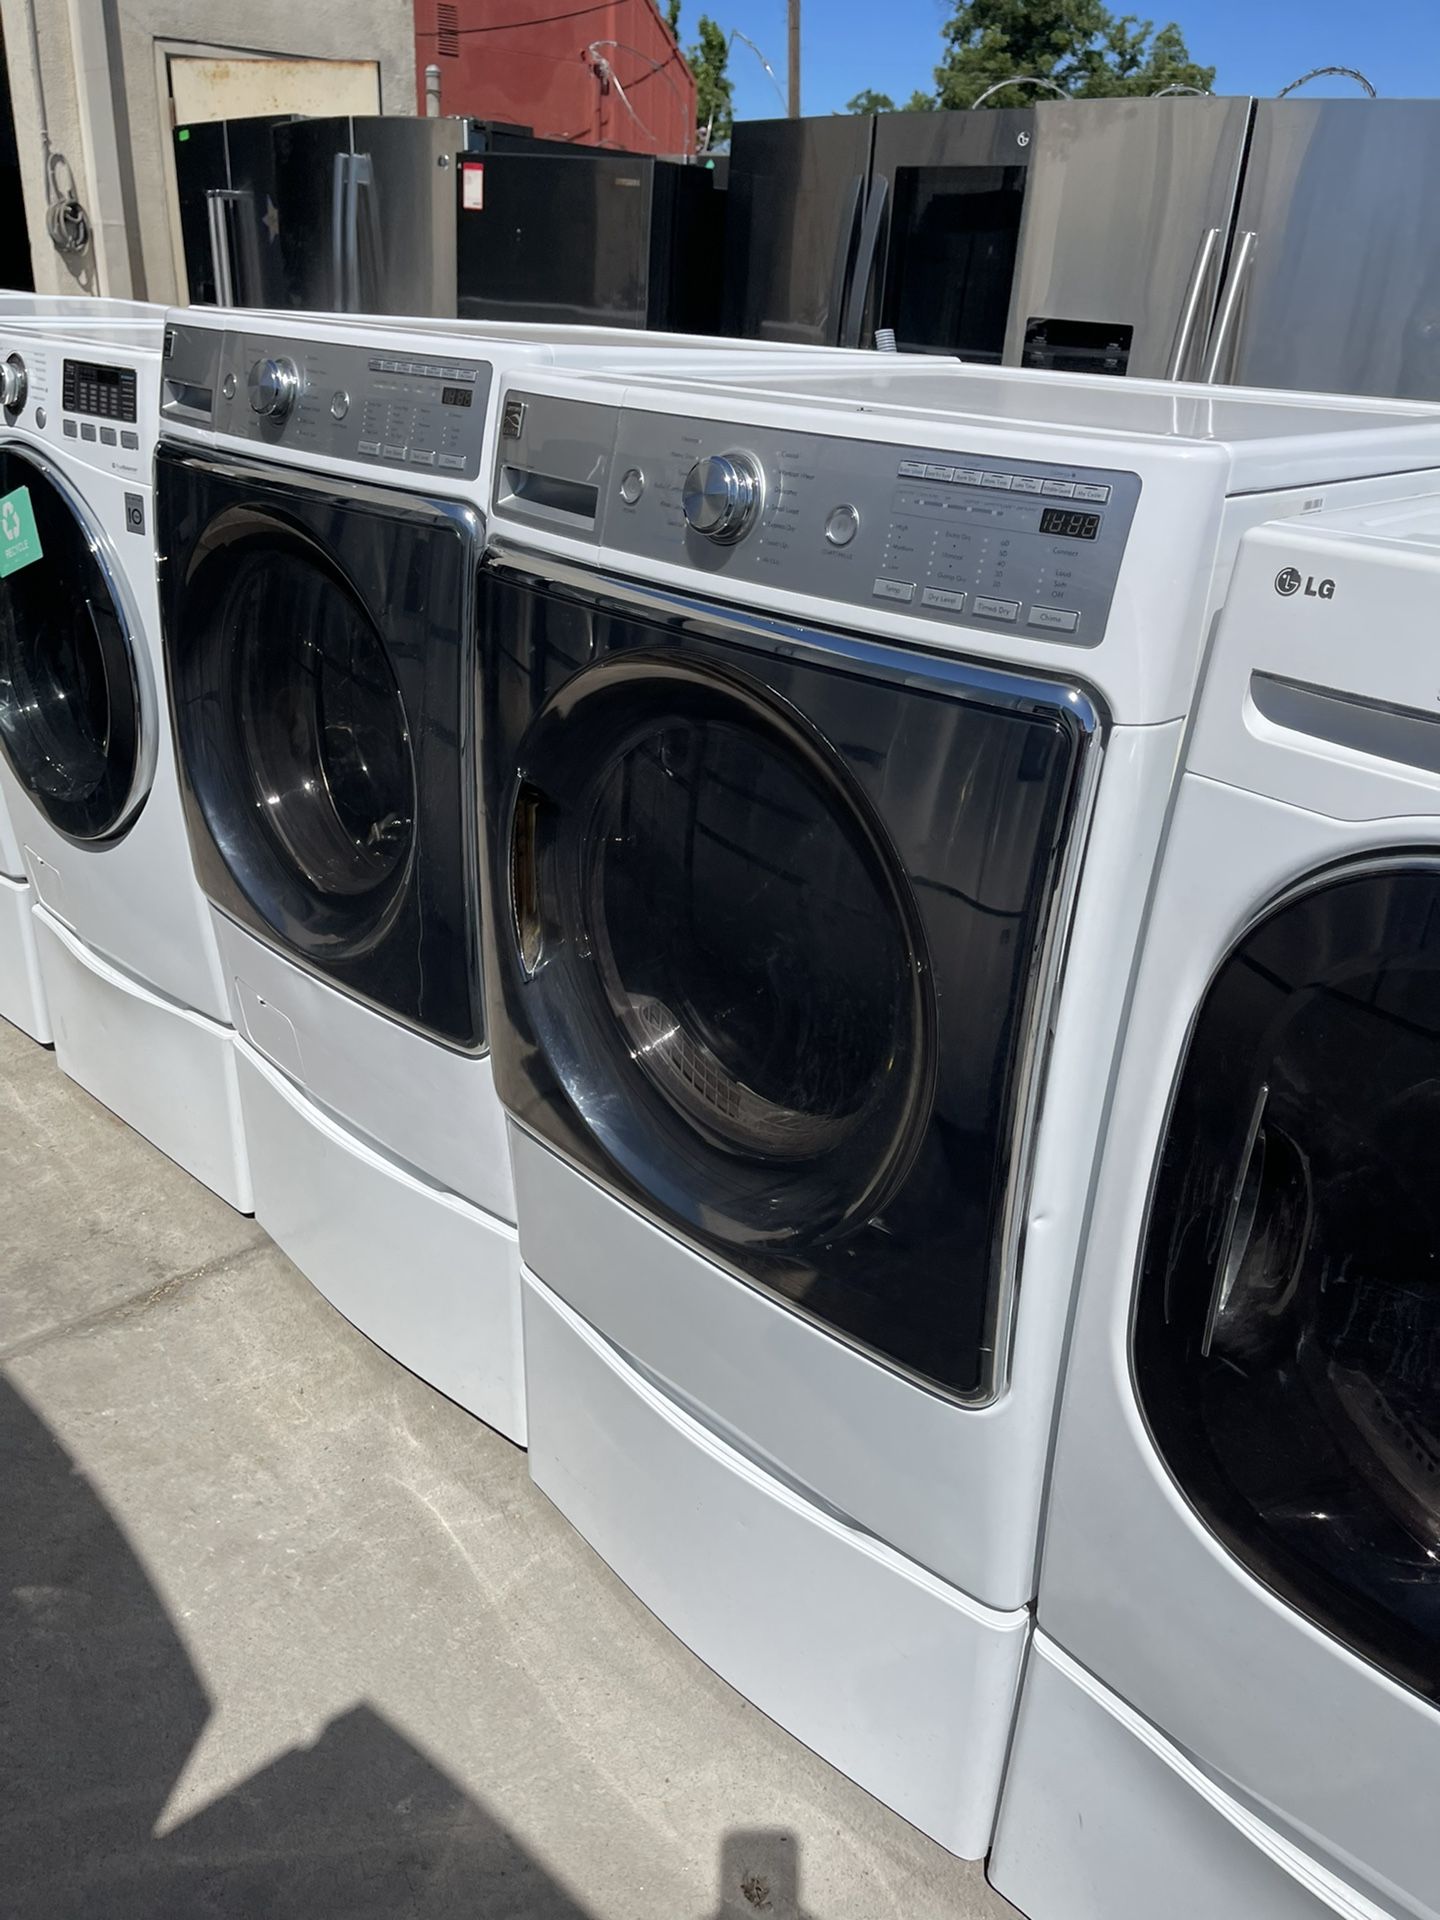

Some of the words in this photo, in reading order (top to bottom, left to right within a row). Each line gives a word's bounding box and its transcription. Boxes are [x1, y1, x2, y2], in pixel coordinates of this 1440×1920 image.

[4, 539, 29, 559] RECYCLE
[1303, 576, 1336, 600] LG
[928, 593, 940, 603] Dry
[940, 595, 957, 604] Level
[998, 606, 1011, 616] Dry
[1039, 612, 1062, 623] Chime
